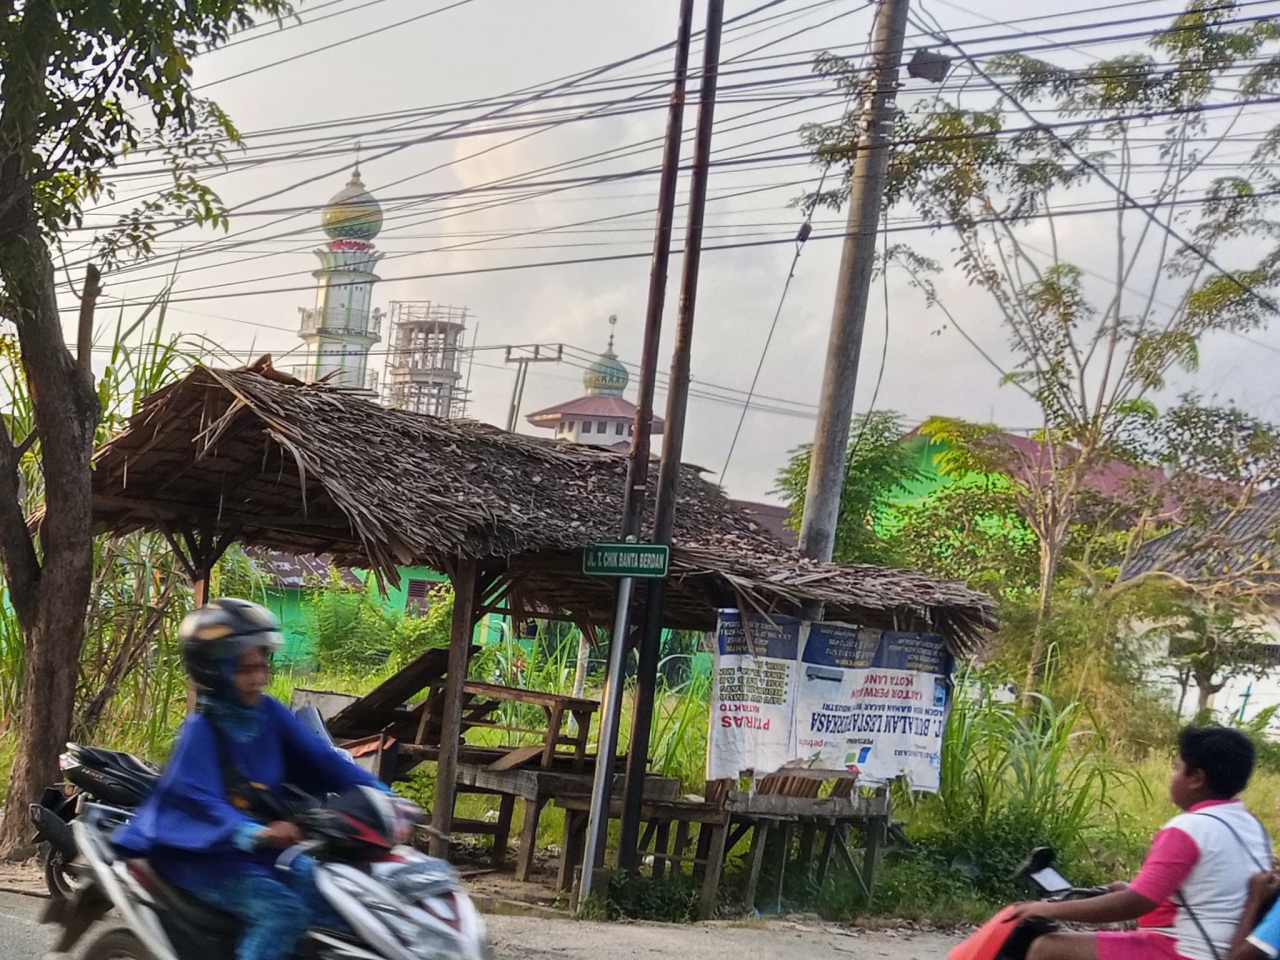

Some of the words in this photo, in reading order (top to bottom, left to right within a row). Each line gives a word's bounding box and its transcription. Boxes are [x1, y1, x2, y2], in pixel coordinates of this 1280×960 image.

[619, 552, 638, 568] BANTA
[639, 553, 665, 569] BERDAN
[890, 676, 914, 687] KOTA
